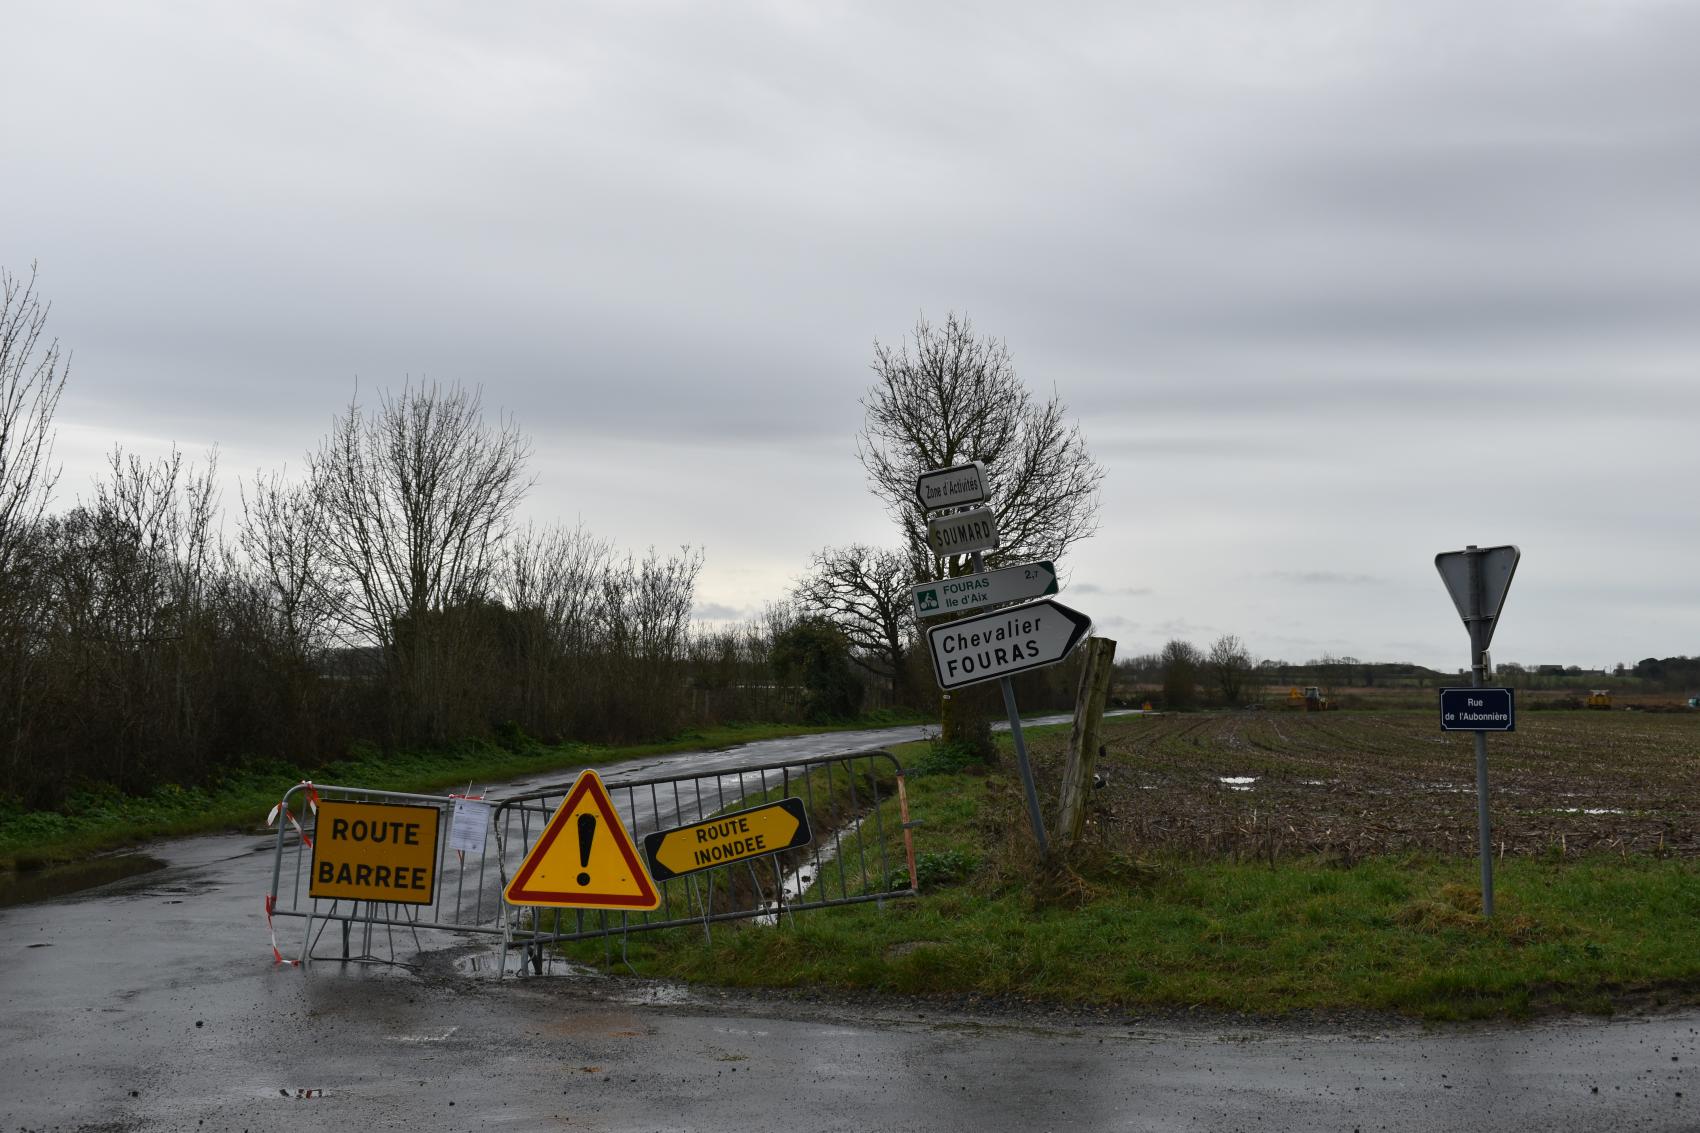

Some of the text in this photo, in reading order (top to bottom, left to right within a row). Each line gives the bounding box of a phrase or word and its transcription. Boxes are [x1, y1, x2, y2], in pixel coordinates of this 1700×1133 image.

[926, 478, 979, 499] Zone d'Activités
[936, 520, 991, 547] SOUMARD
[943, 578, 990, 595] FOURAS
[945, 592, 988, 608] Ile d'Aix
[943, 617, 1041, 654] Chevalier
[947, 639, 1040, 678] FOURAS
[1467, 698, 1484, 707] Rue
[1445, 712, 1508, 721] de l'Aubonnière
[333, 819, 420, 845] ROUTE
[697, 818, 749, 843] ROUTE
[694, 835, 766, 865] INONDEE
[319, 862, 426, 889] BARREE
